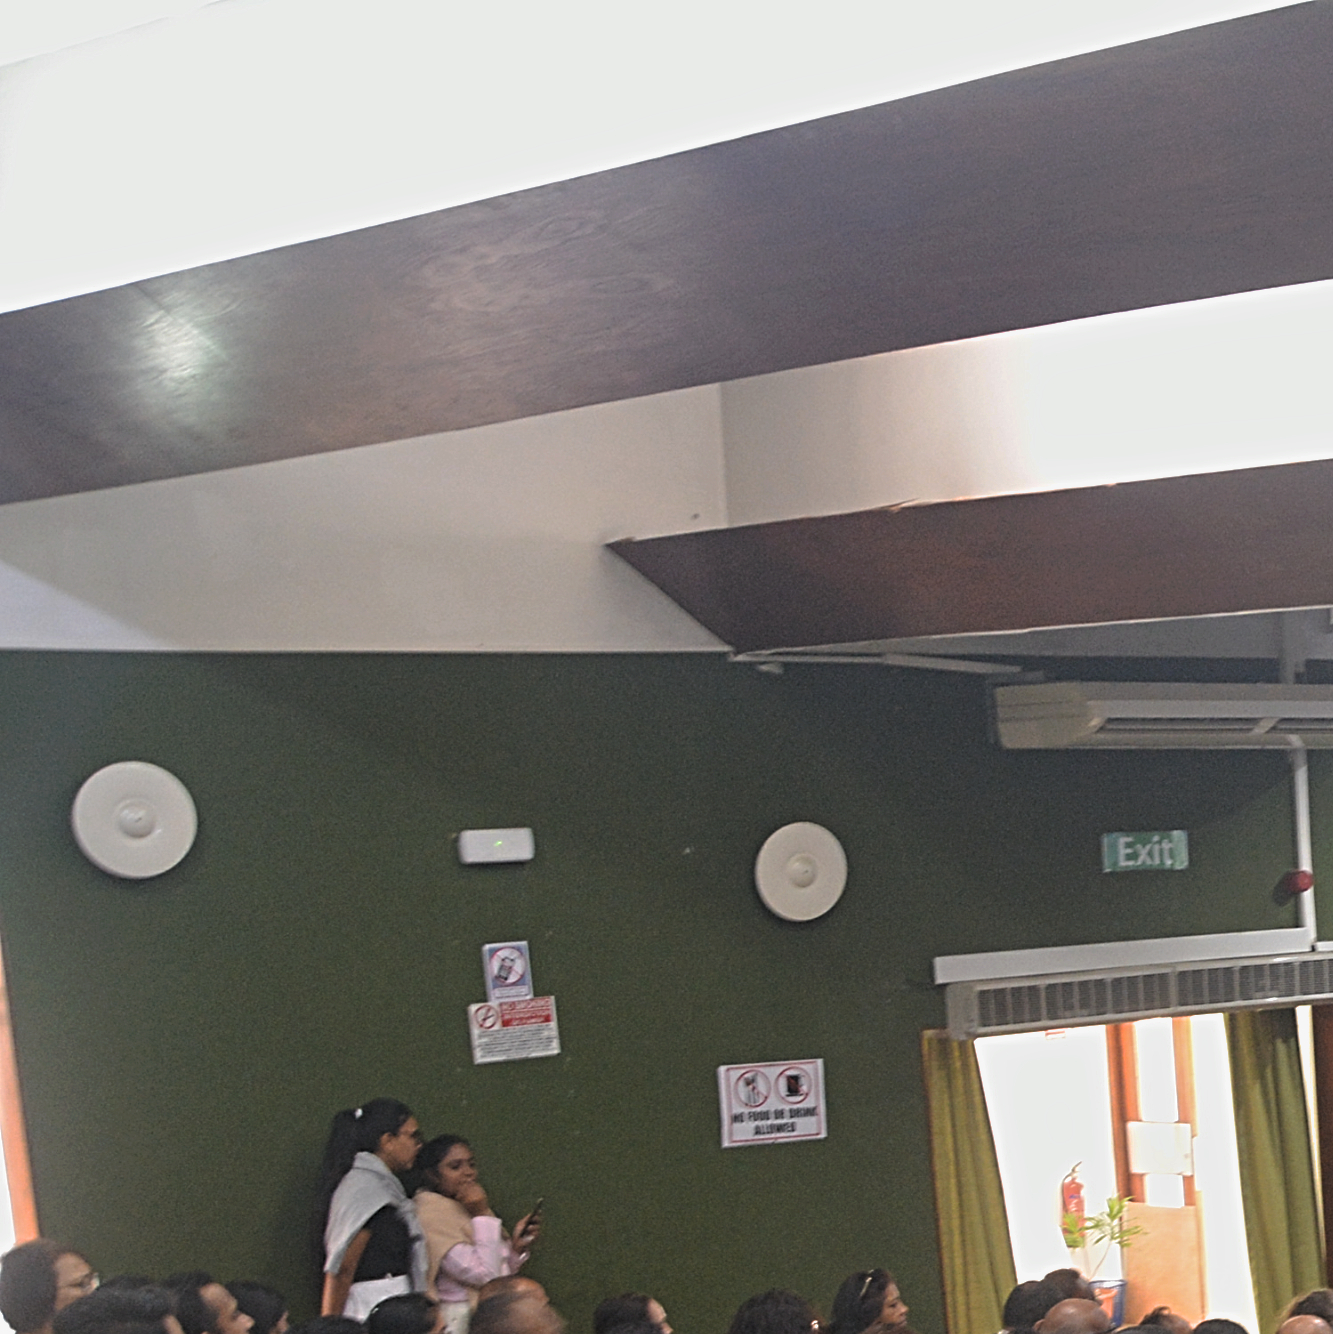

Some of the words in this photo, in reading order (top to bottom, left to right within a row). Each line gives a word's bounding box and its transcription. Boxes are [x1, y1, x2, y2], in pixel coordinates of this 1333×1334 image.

[1119, 835, 1174, 867] Exit
[733, 1111, 744, 1124] NO
[748, 1110, 770, 1122] FOOD
[789, 1106, 818, 1119] DRINK
[754, 1122, 797, 1136] ALLOWED
